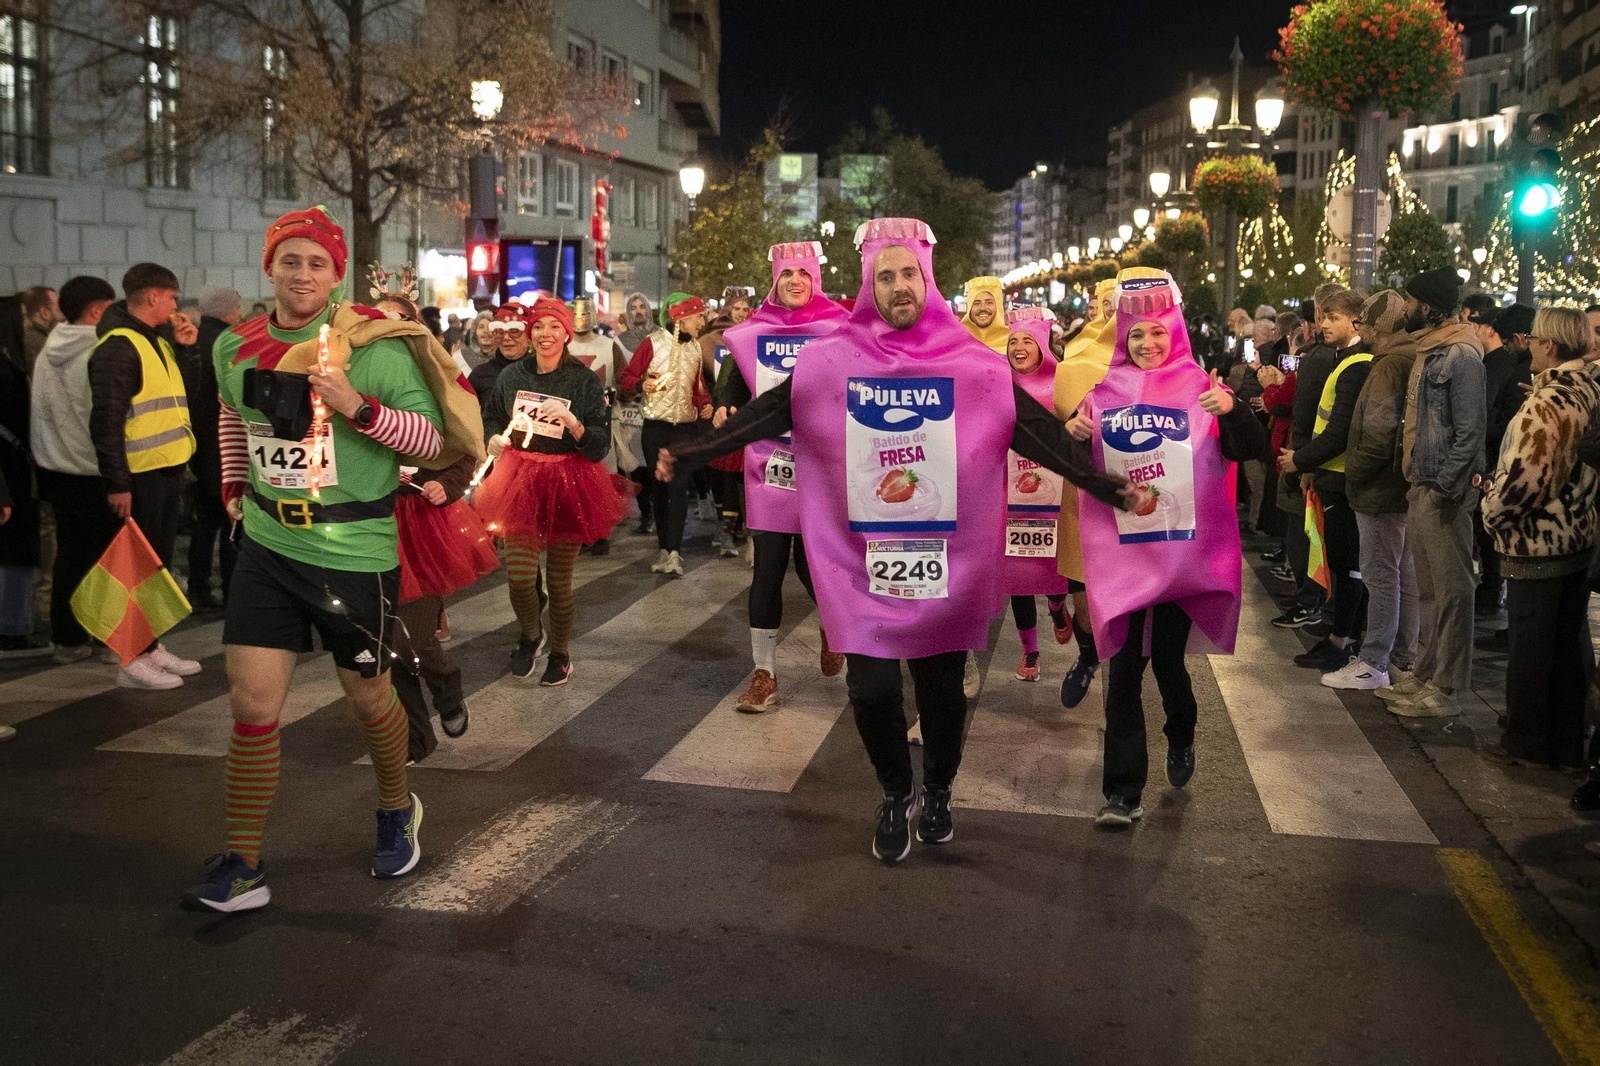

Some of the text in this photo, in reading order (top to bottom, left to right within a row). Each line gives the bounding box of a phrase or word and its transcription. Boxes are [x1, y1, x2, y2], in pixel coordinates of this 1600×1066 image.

[1124, 280, 1166, 289] PULEVA
[765, 341, 806, 356] PULE
[859, 386, 941, 406] PULEVA
[1111, 414, 1177, 433] PULEVA
[872, 432, 927, 449] Batido de
[879, 445, 926, 467] FRESA
[1017, 459, 1042, 471] FRES
[1123, 450, 1166, 469] Batido de
[770, 464, 795, 479] 19
[1128, 463, 1166, 484] FRESA
[1010, 532, 1054, 546] 2086
[872, 560, 943, 581] 2249
